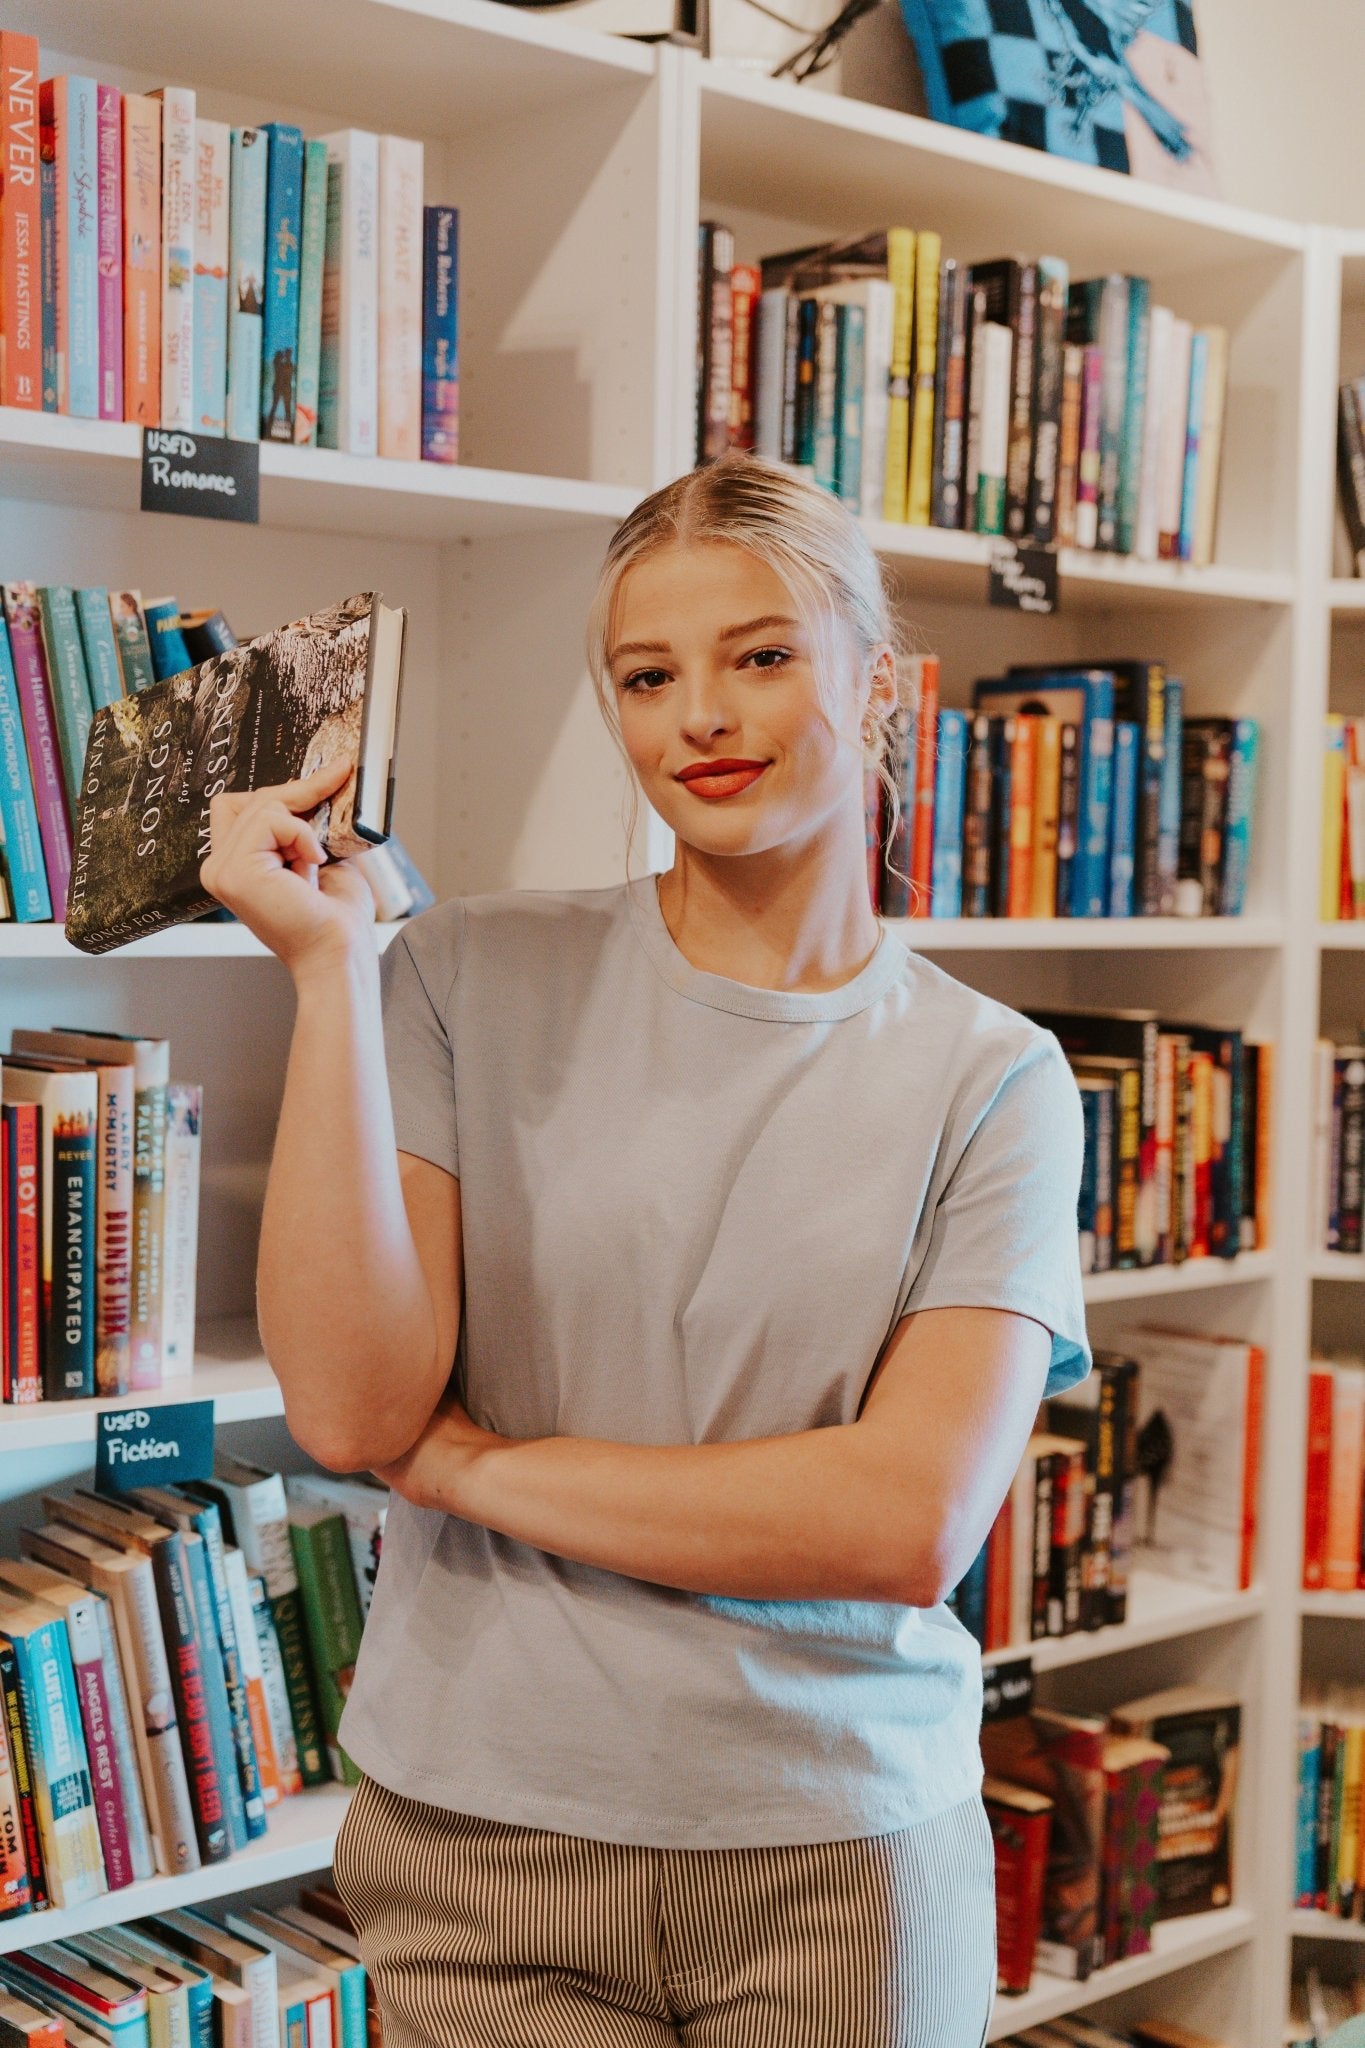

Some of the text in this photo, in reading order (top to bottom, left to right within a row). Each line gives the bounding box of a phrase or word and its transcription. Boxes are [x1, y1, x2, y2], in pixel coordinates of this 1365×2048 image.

[8, 67, 35, 185] NEVER
[197, 141, 215, 236] PERFECT
[358, 210, 372, 259] LOVE
[14, 212, 30, 350] JESSA HASTINGS
[147, 431, 197, 458] USED
[148, 456, 237, 496] Romance
[251, 737, 259, 756] Night
[256, 689, 264, 713] Lobster
[138, 720, 172, 857] SONGS
[177, 749, 194, 803] for the
[197, 672, 237, 859] MISSING
[72, 807, 97, 917] STEWART
[87, 719, 107, 794] O'NAN
[83, 910, 168, 945] SONGS FOR
[22, 1122, 32, 1154] THE
[58, 1151, 92, 1161] REYES
[120, 1112, 130, 1171] LARRY
[136, 1104, 151, 1177] PALACE
[18, 1164, 36, 1217] BOY
[65, 1176, 83, 1344] EMANCIPATED
[104, 1294, 127, 1335] LICK
[104, 1410, 150, 1431] USED
[107, 1437, 180, 1465] Fiction
[42, 1658, 62, 1703] CLIVE
[83, 1671, 112, 1790] ANGEL'S REST
[3, 1805, 17, 1853] TOM
